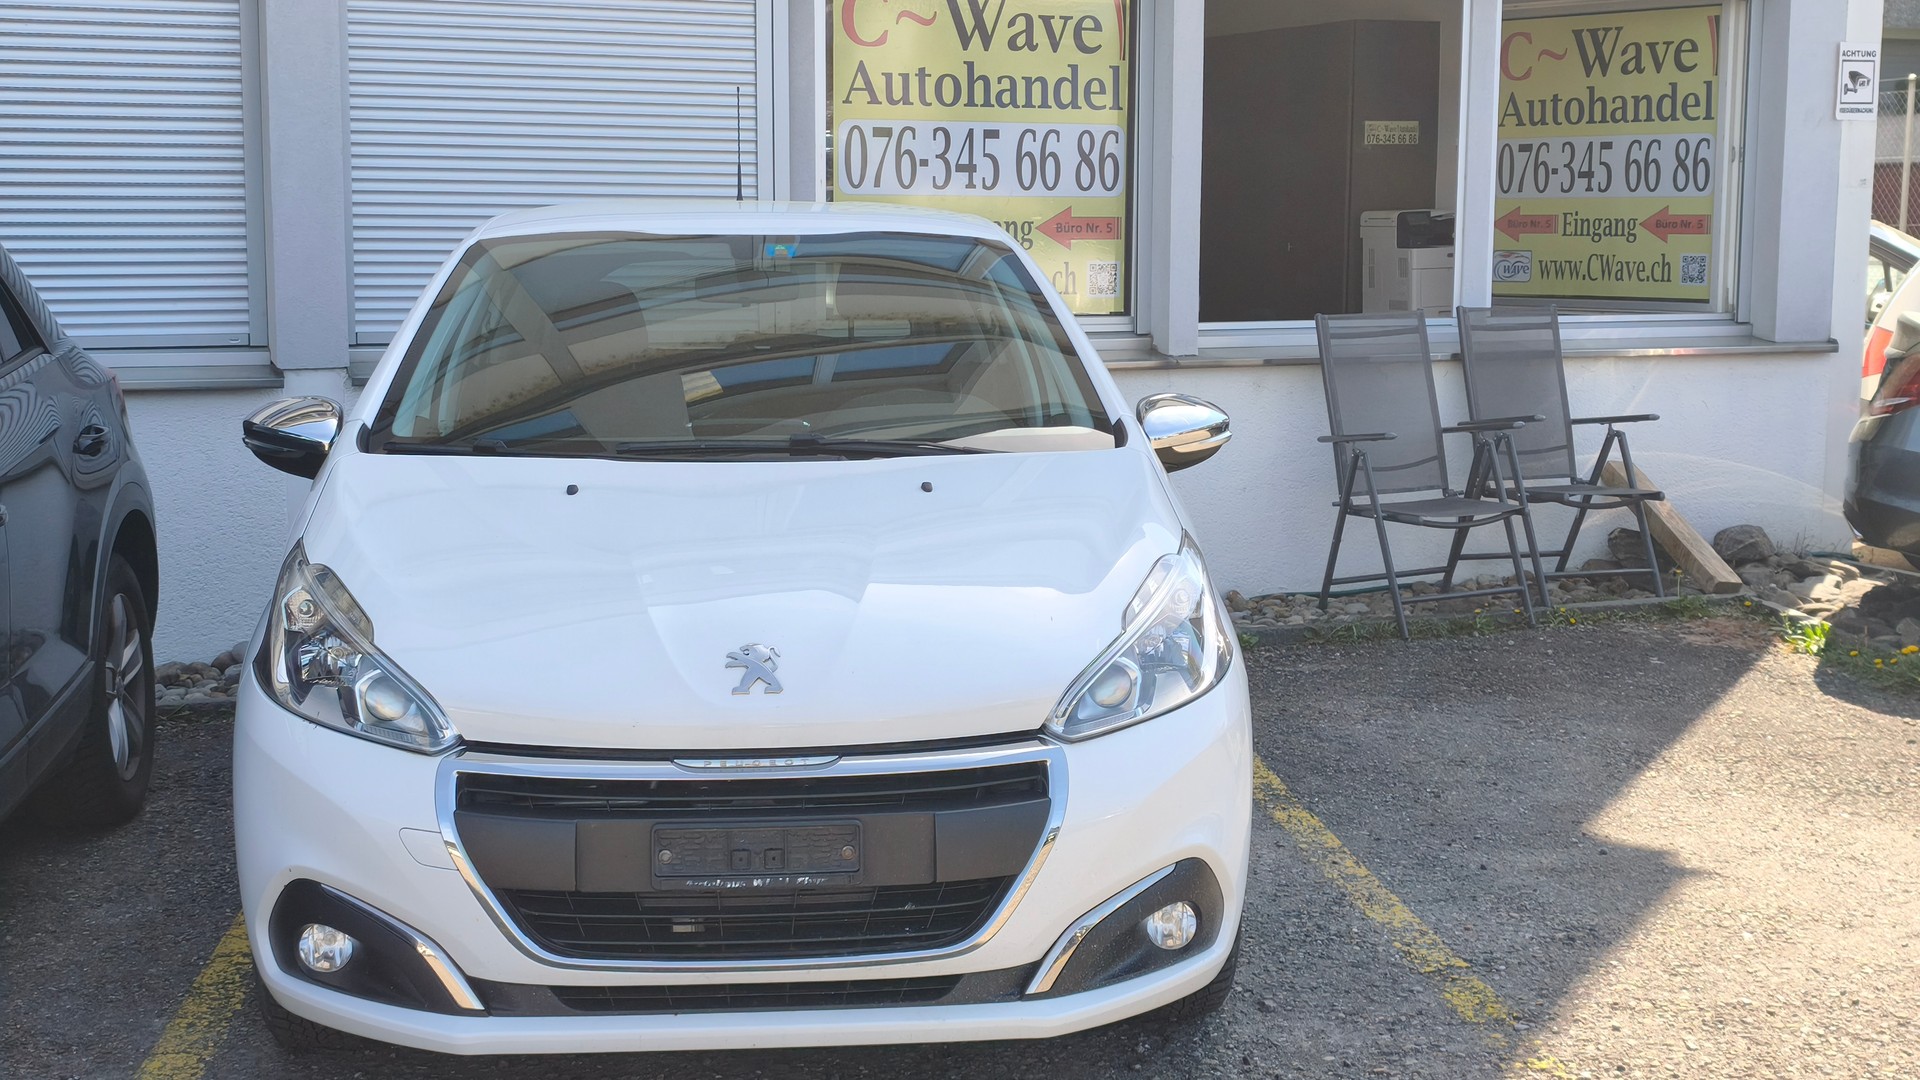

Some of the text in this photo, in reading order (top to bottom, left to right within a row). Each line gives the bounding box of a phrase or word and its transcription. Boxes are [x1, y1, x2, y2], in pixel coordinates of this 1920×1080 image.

[842, 60, 1124, 111] Autohandel
[1498, 80, 1714, 127] Autohandel
[1366, 133, 1418, 144] 076-345 66 86
[844, 125, 1120, 192] 076-345 66 86
[1499, 138, 1711, 194] 076-345 66 86
[1056, 222, 1113, 233] Büro Nr. 5
[1507, 219, 1551, 229] Büro Nr. 5
[1562, 211, 1638, 243] Eingang
[1655, 219, 1703, 229] Büro Nr. 5
[1538, 253, 1672, 283] www.CWave.ch
